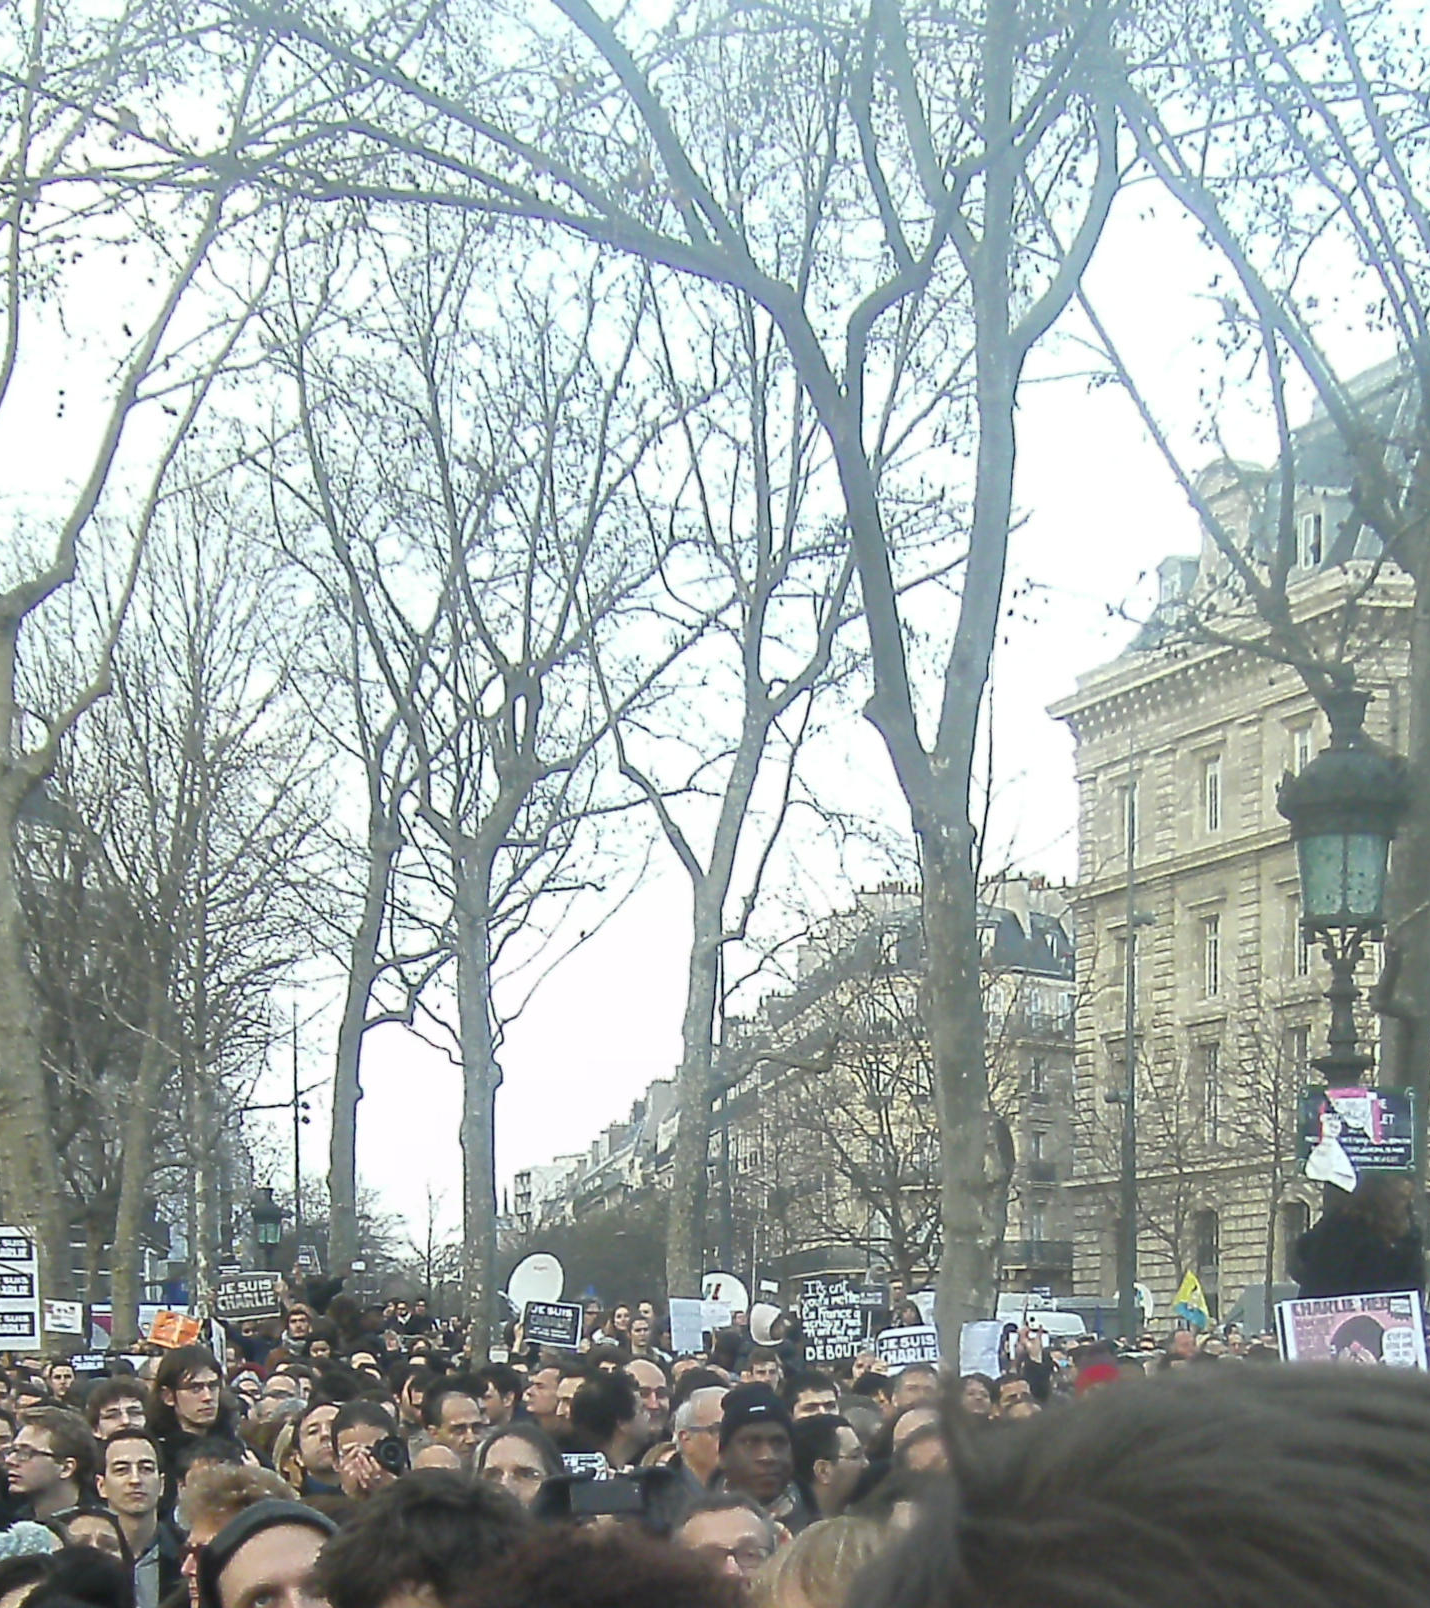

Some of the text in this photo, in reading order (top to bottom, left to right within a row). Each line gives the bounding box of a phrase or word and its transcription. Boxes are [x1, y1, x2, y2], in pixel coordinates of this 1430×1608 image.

[217, 1279, 272, 1295] JE SUIS
[217, 1291, 276, 1311] CHARLIE
[879, 1334, 936, 1350] JE SUIS
[805, 1342, 861, 1361] DEBOUT
[880, 1347, 939, 1365] CHARLIE
